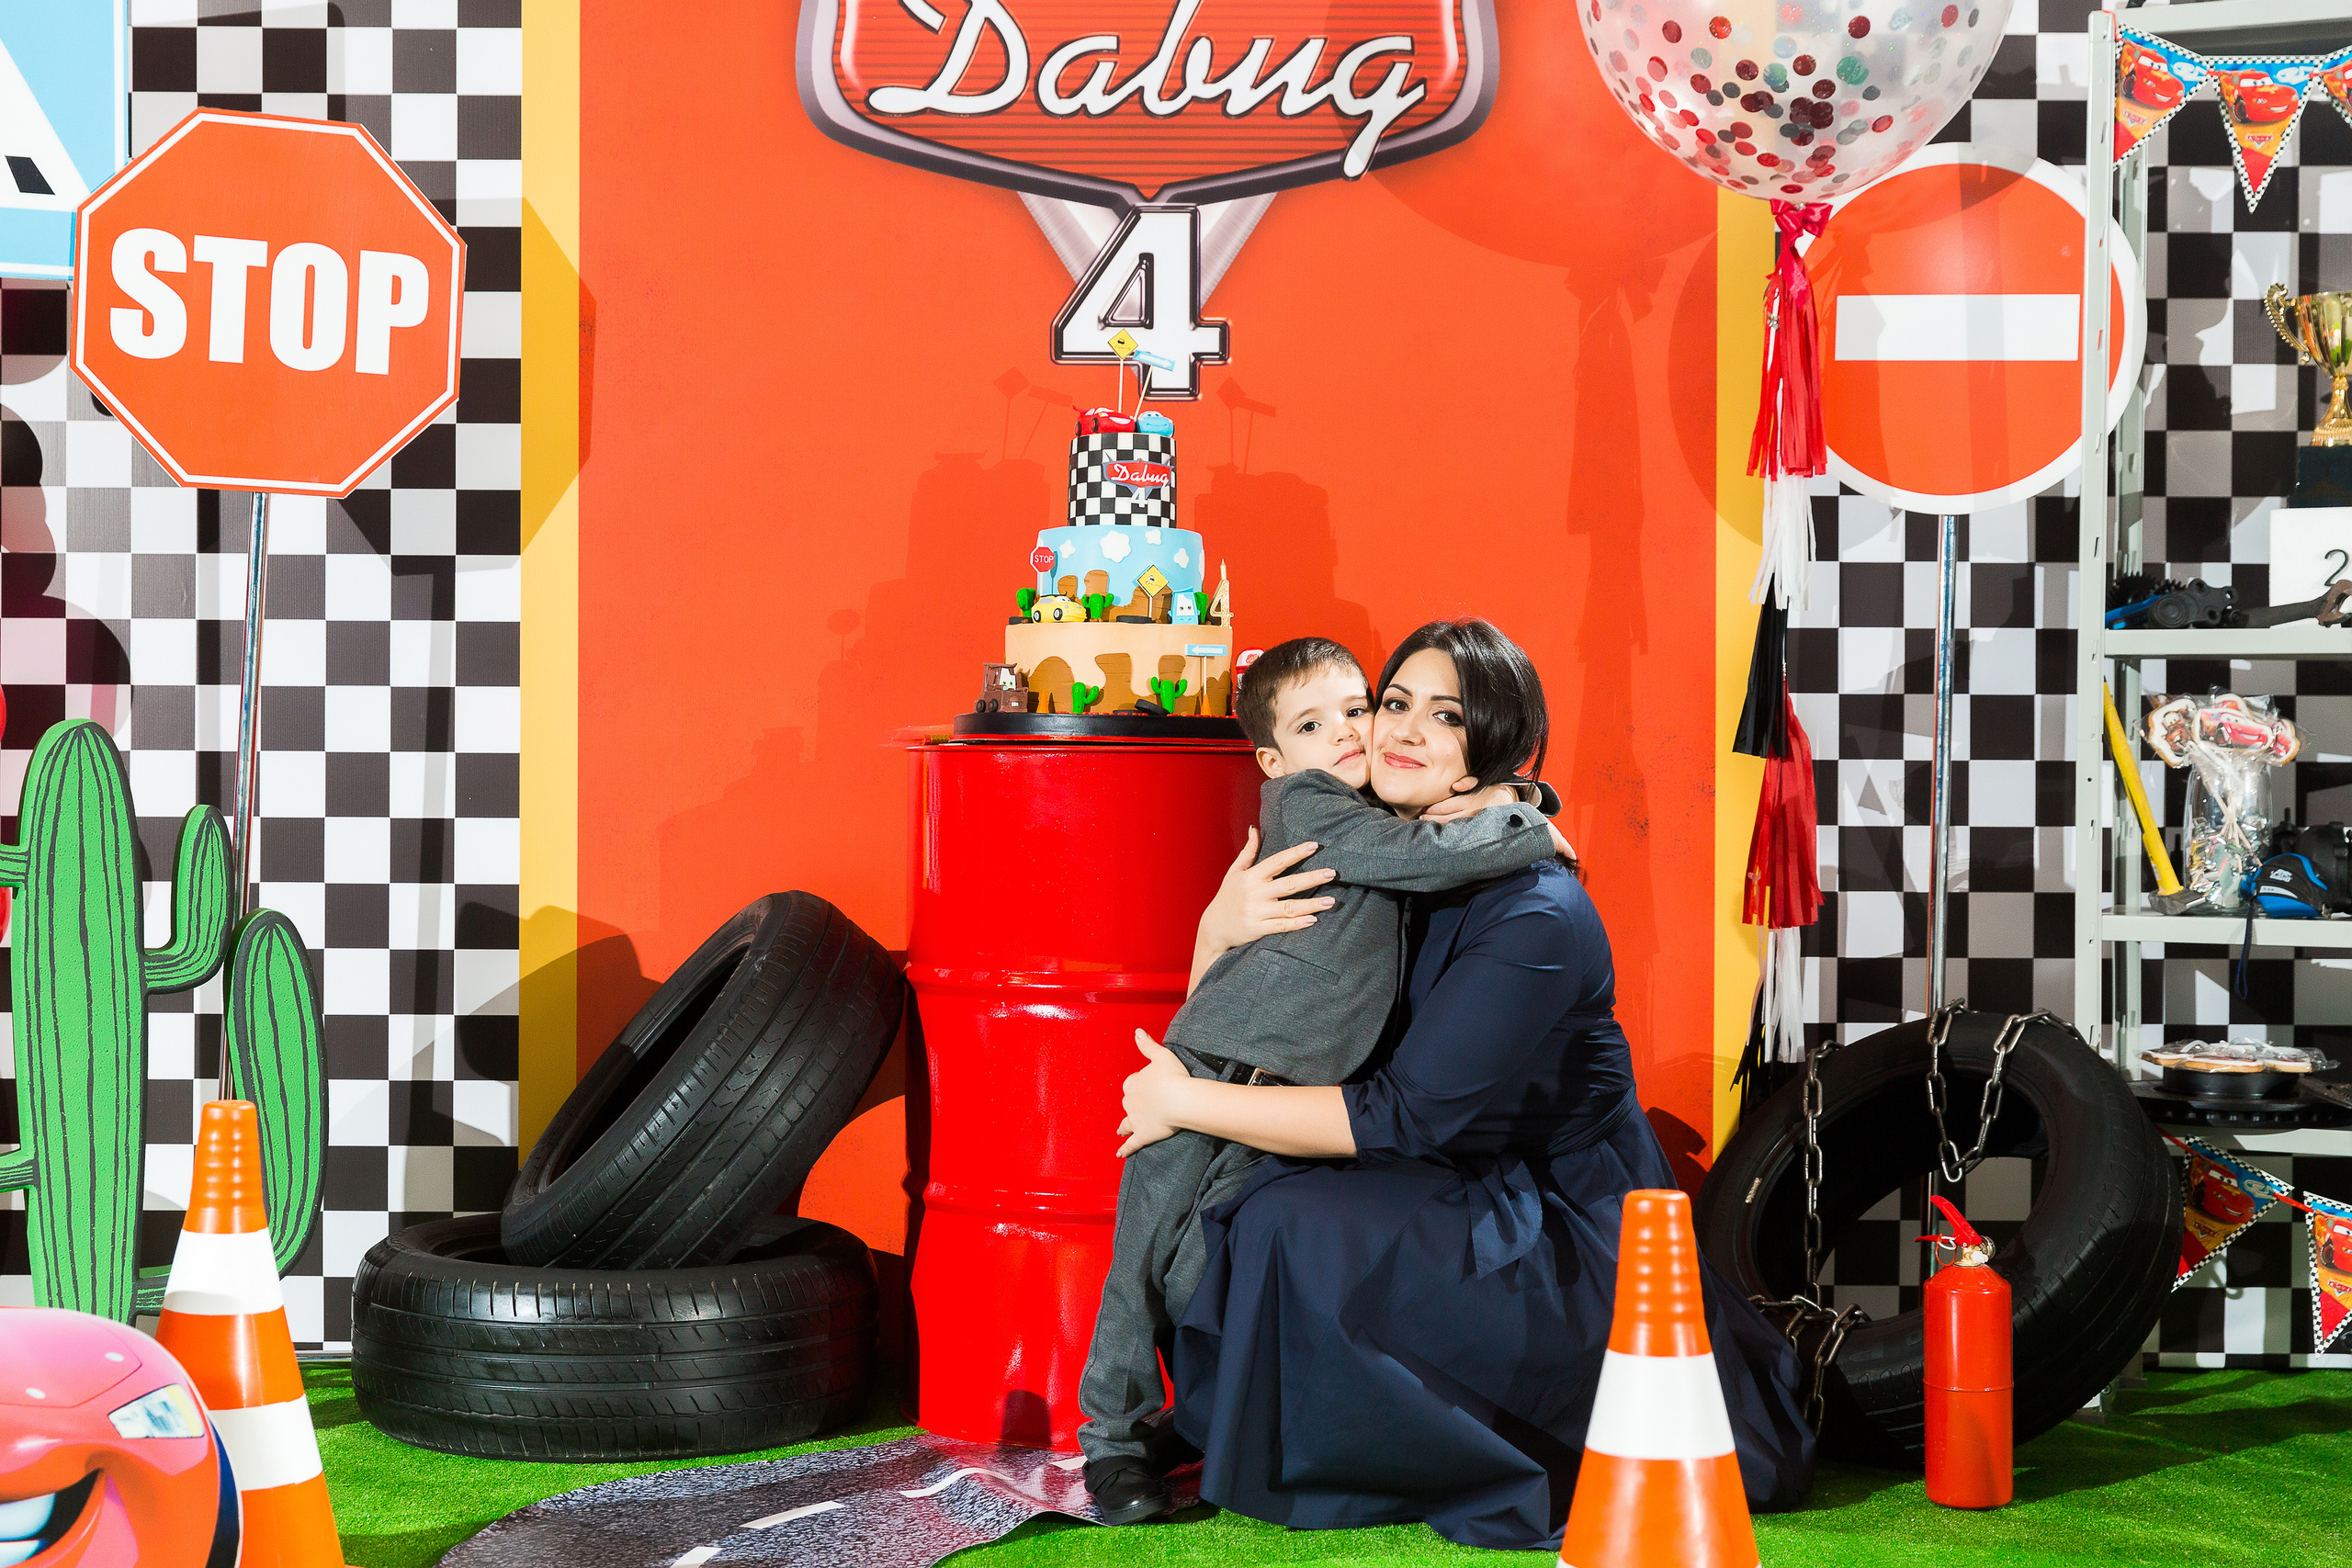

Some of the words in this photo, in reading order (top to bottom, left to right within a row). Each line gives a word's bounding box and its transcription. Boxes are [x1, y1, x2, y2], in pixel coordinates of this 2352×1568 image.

[868, 0, 1427, 179] Dabug
[109, 228, 429, 376] STOP
[1051, 203, 1229, 400] 4
[1111, 463, 1170, 490] Dabug
[1130, 487, 1148, 508] 4
[1034, 554, 1055, 564] STOP
[1209, 579, 1235, 627] 4
